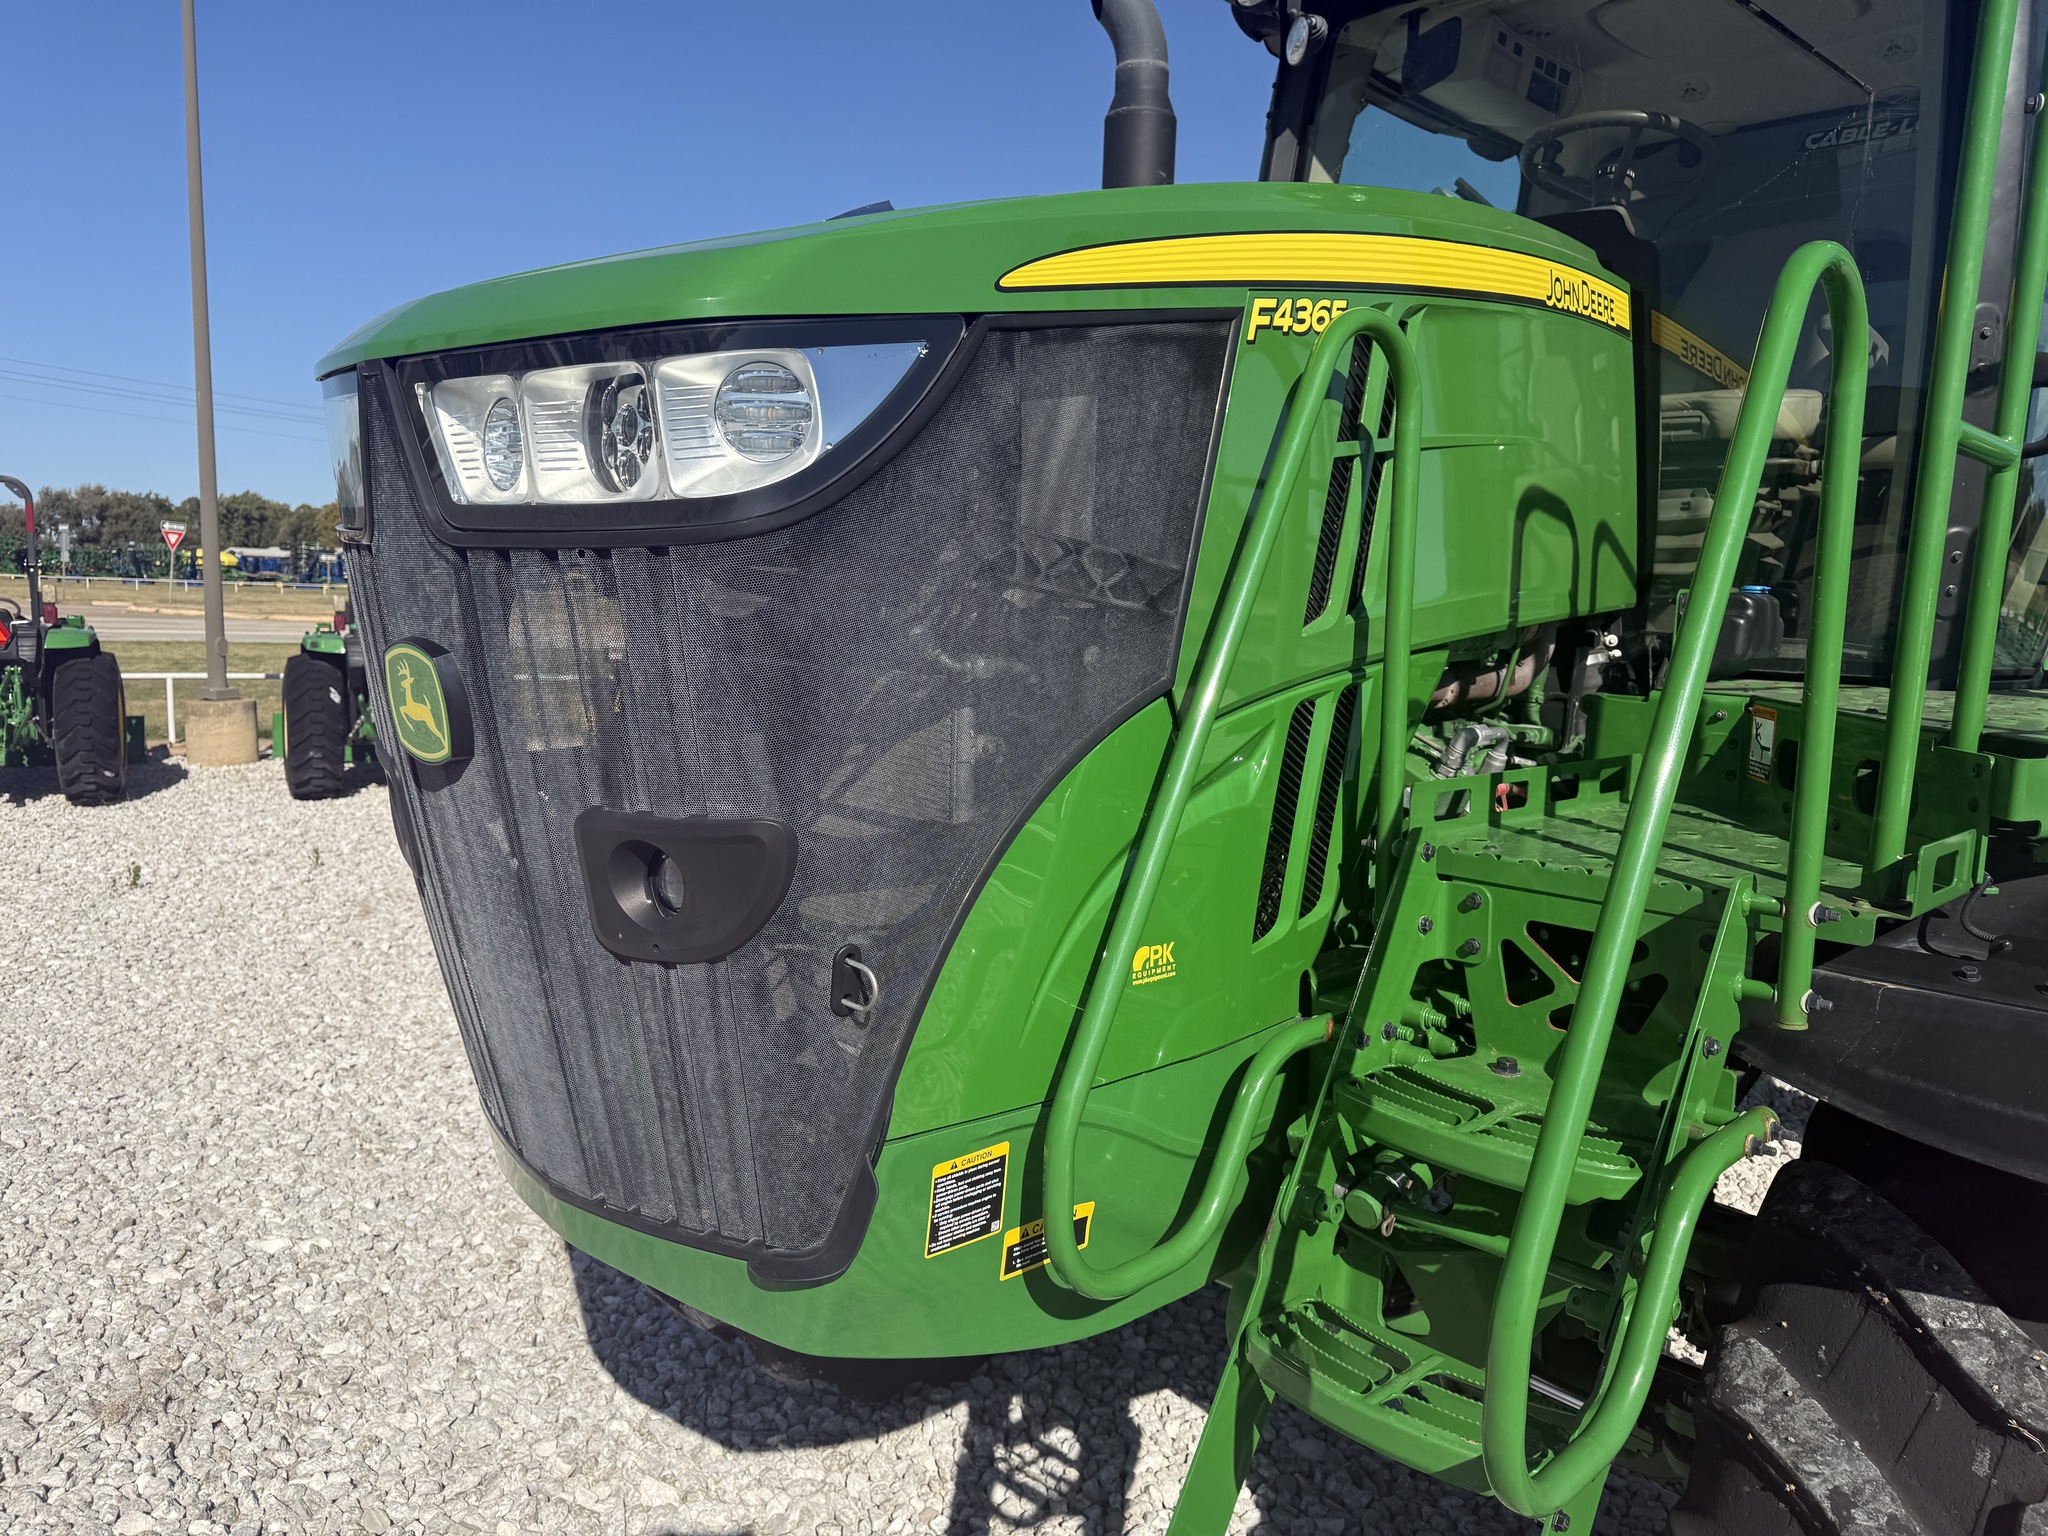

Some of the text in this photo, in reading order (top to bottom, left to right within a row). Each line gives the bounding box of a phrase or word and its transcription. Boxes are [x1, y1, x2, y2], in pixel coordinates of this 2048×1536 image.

[1546, 268, 1616, 324] JOHN DEERE
[1132, 964, 1176, 979] EQUIPMENT
[961, 1150, 993, 1167] CAUTION
